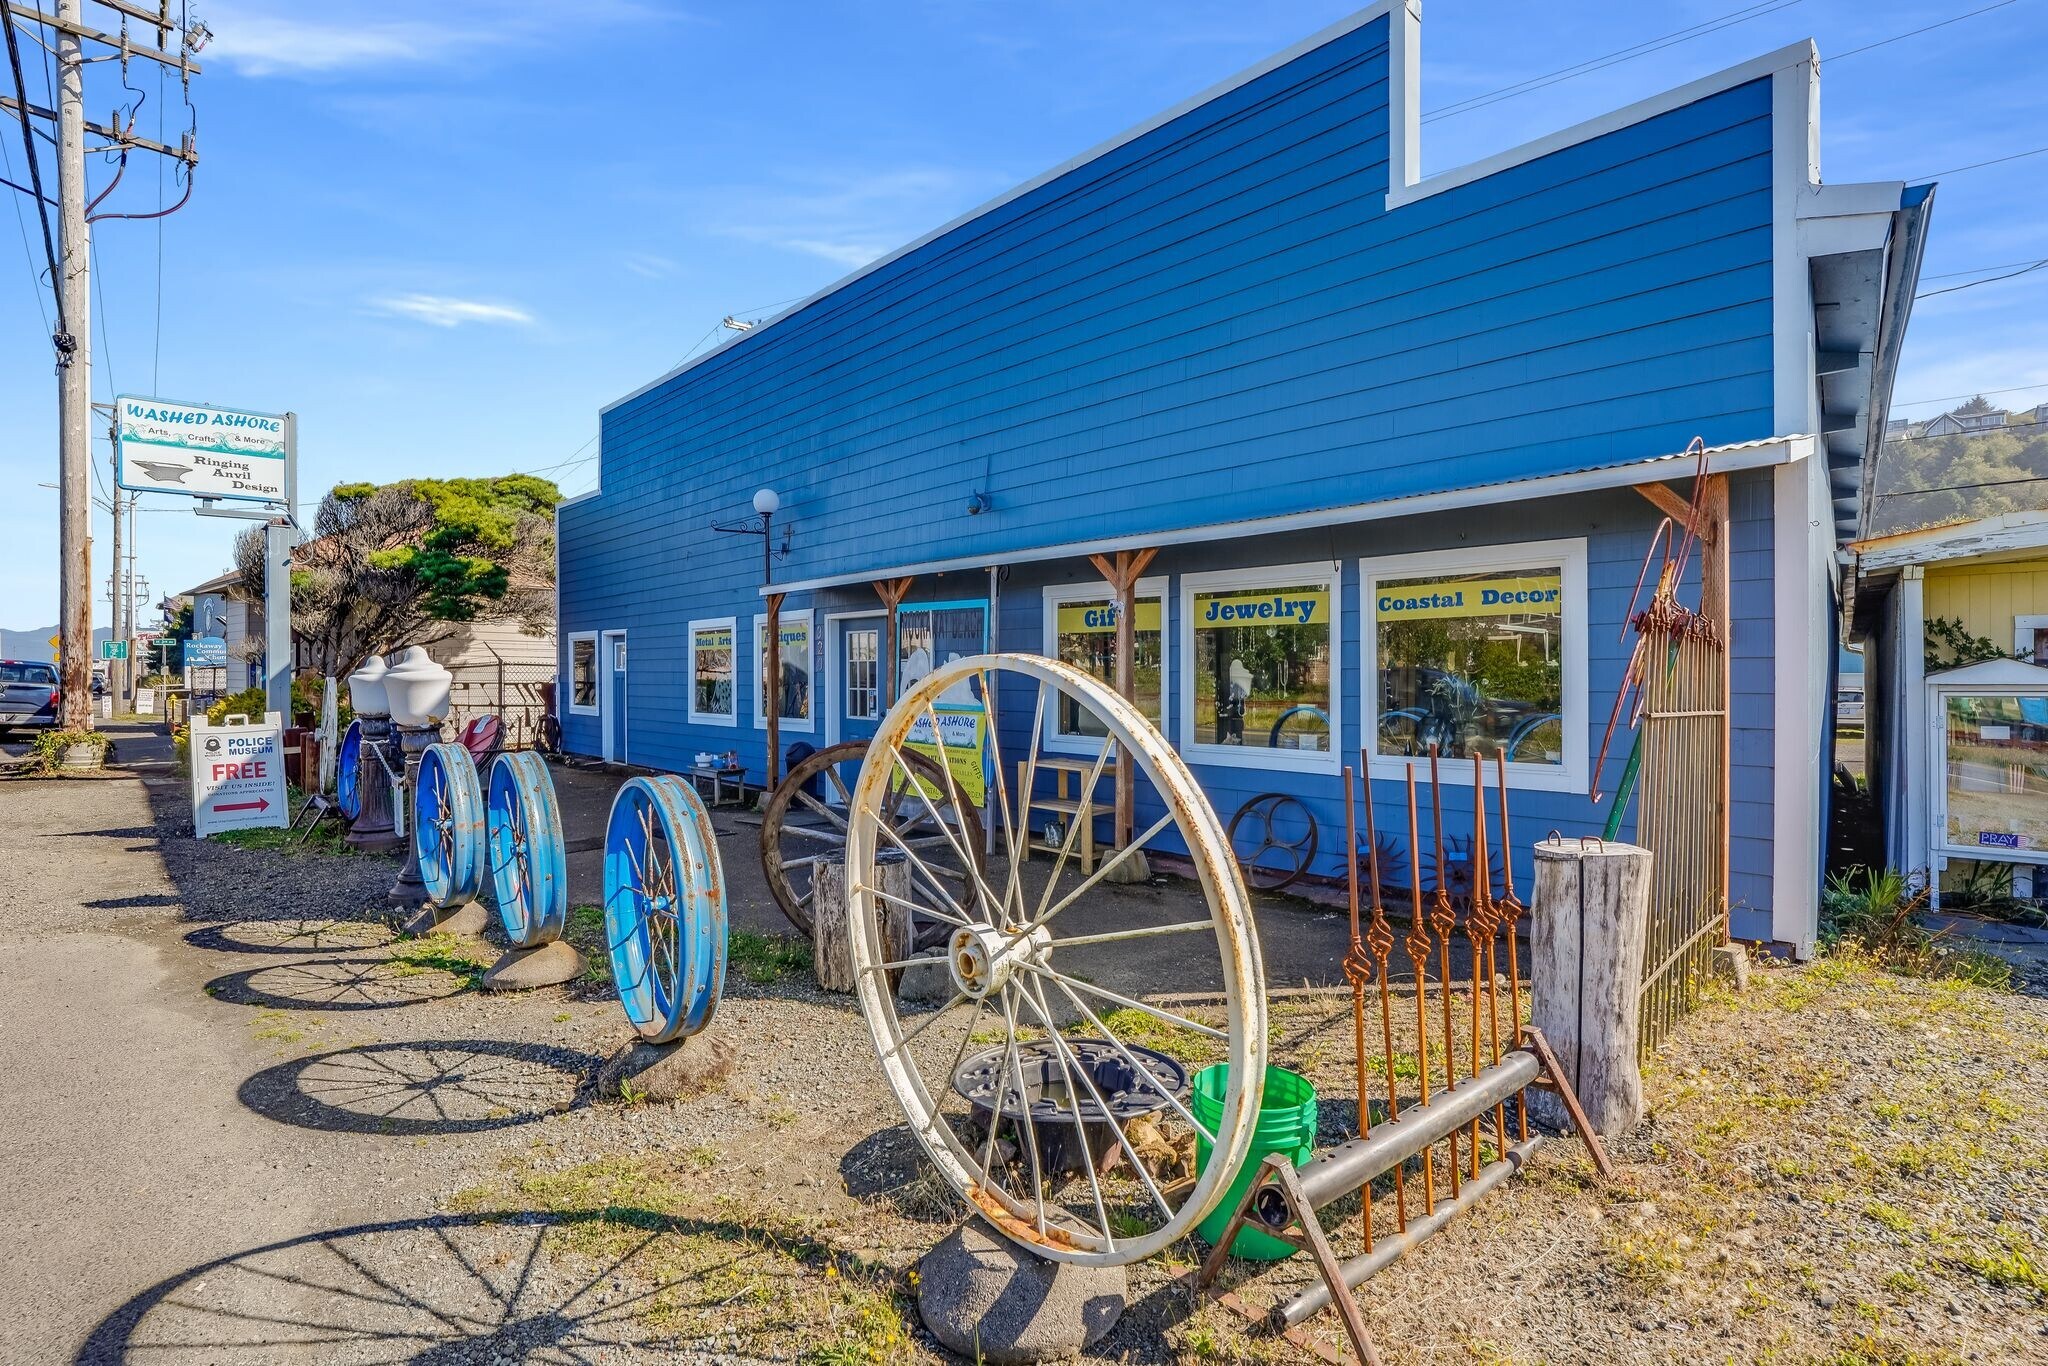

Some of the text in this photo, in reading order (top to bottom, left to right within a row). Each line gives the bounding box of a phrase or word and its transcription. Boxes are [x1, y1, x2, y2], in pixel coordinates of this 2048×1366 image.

[127, 403, 280, 433] WASHED ASHORE
[148, 427, 171, 437] Arts,
[188, 433, 218, 444] Crafts,
[243, 436, 266, 445] More
[193, 455, 250, 471] Ringing
[212, 468, 251, 480] Anvil
[231, 480, 278, 493] Design
[1378, 588, 1559, 612] Coastal Decor
[1206, 597, 1316, 622] Jewelry
[186, 642, 223, 650] Rockaway
[696, 638, 714, 647] Metal
[941, 716, 975, 728] ASHORE
[228, 737, 272, 747] POLICE
[228, 746, 273, 756] MUSEUM
[212, 762, 267, 781] FREE
[971, 761, 983, 780] GIFTS
[1981, 833, 2016, 844] PRAY
